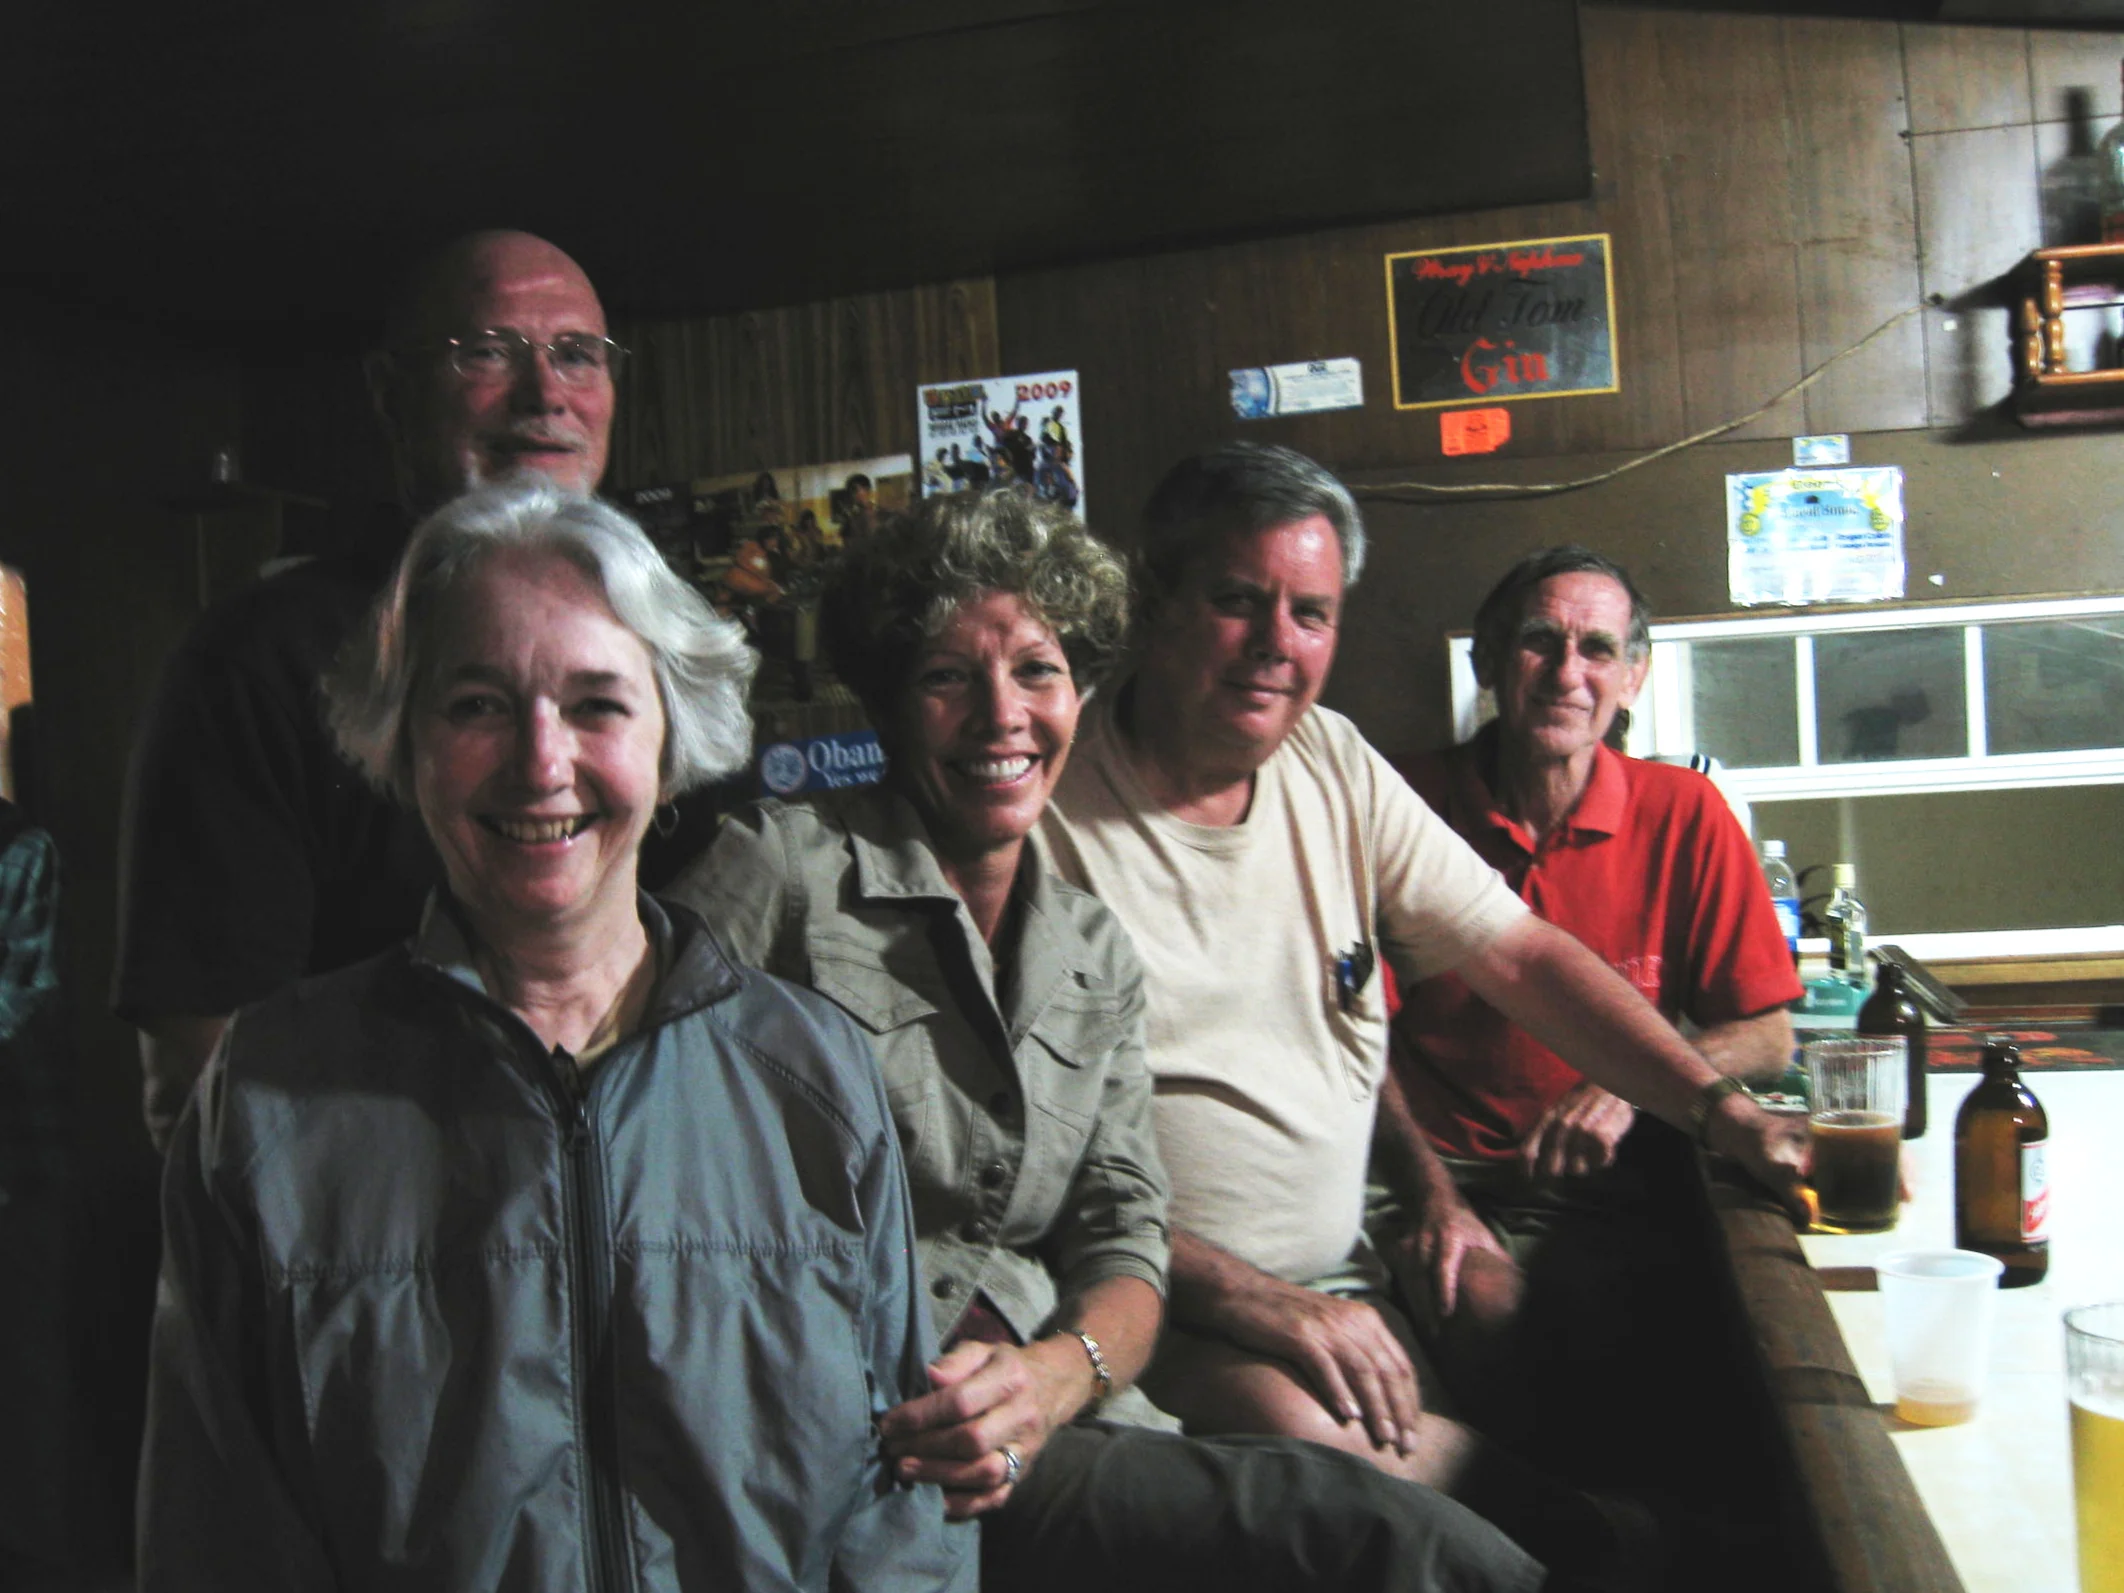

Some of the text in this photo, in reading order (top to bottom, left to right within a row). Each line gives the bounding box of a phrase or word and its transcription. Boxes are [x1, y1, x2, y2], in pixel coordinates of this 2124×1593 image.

[1417, 277, 1586, 338] Old Tom
[1016, 379, 1072, 401] 2009
[1461, 337, 1549, 394] Gin
